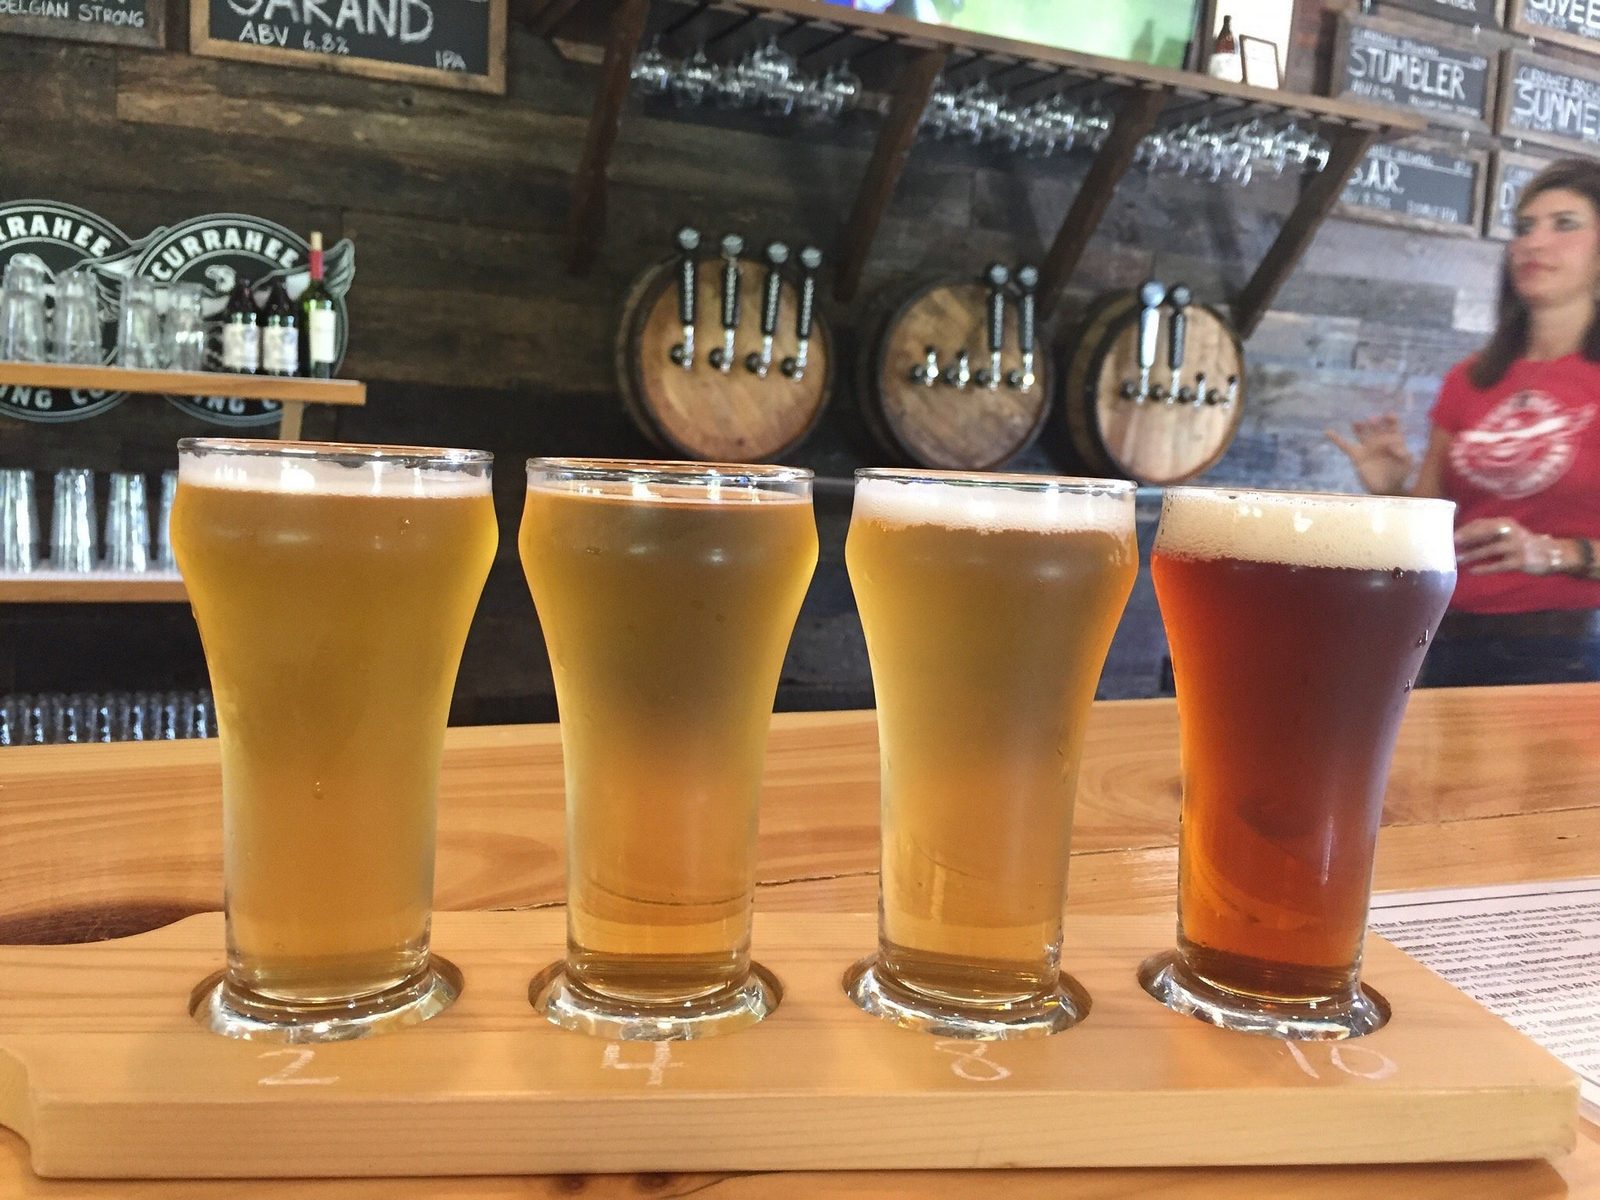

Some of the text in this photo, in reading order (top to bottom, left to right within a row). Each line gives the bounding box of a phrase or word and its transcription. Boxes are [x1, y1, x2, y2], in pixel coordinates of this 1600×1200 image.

[78, 3, 145, 28] STRONG
[238, 20, 289, 46] ABV
[434, 49, 467, 72] IPA
[1347, 46, 1466, 100] STUMBLER
[0, 214, 112, 258] RAHEE
[150, 227, 300, 281] CURRAHEE
[258, 1048, 340, 1086] 2
[601, 1039, 684, 1086] 4
[934, 1040, 1012, 1082] 8
[1282, 1038, 1398, 1081] 10
